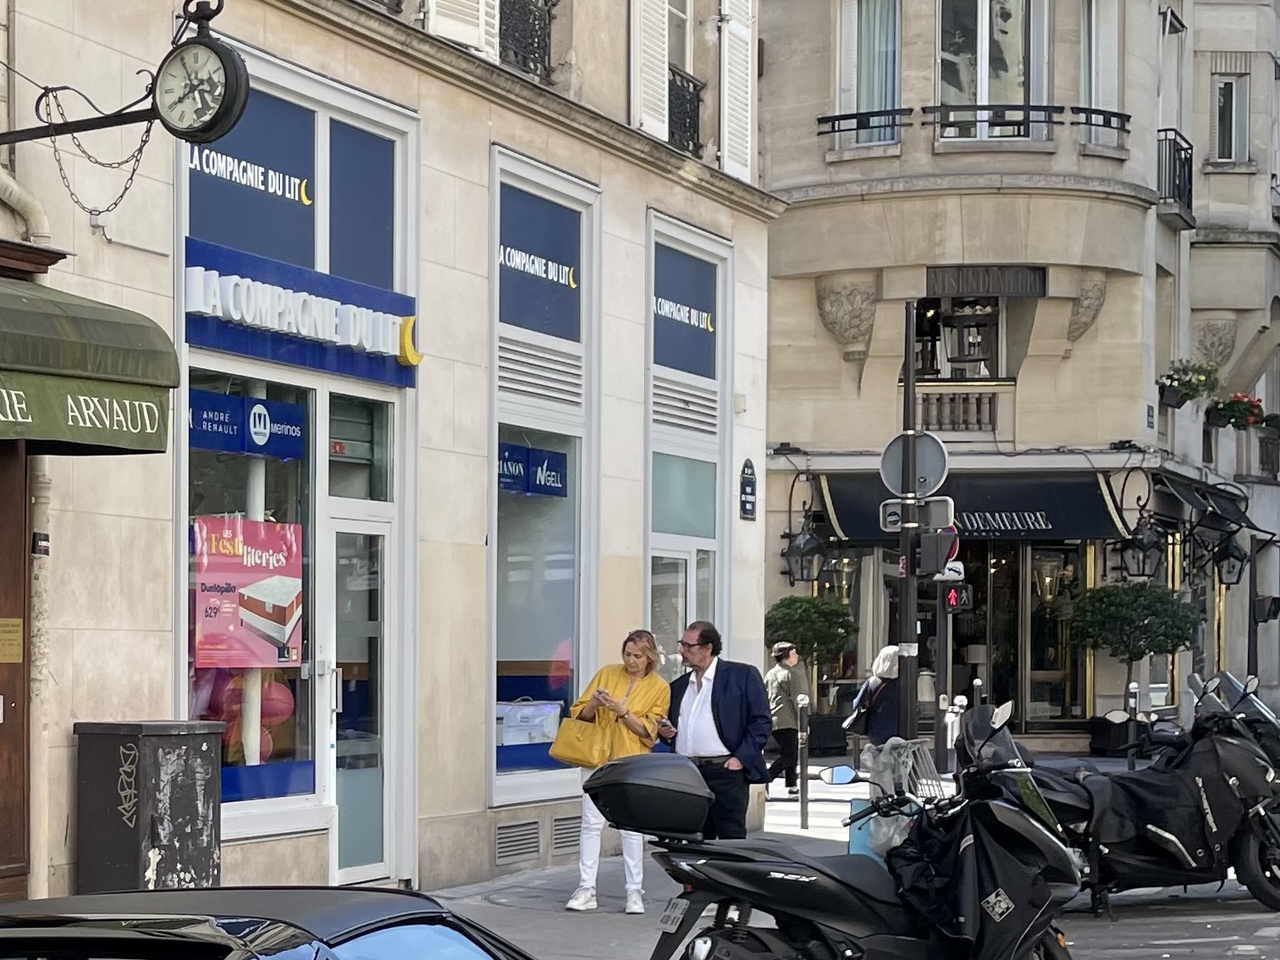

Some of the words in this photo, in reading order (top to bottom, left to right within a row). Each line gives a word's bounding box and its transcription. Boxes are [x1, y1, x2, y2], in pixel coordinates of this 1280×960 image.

[188, 145, 201, 170] LA
[202, 149, 265, 190] COMPAGNIE
[268, 169, 283, 196] DU
[285, 175, 300, 201] LIT
[505, 246, 547, 278] COMPAGNIE
[548, 261, 558, 282] DU
[559, 265, 570, 285] LIT
[185, 266, 223, 317] LA
[219, 275, 342, 344] COMPAGNIE
[336, 304, 373, 350] DU
[367, 311, 403, 356] LIT
[658, 298, 690, 324] COMPAGNIE
[691, 308, 699, 327] DU
[67, 393, 160, 433] ARVAUD
[202, 421, 238, 435] RENAULT
